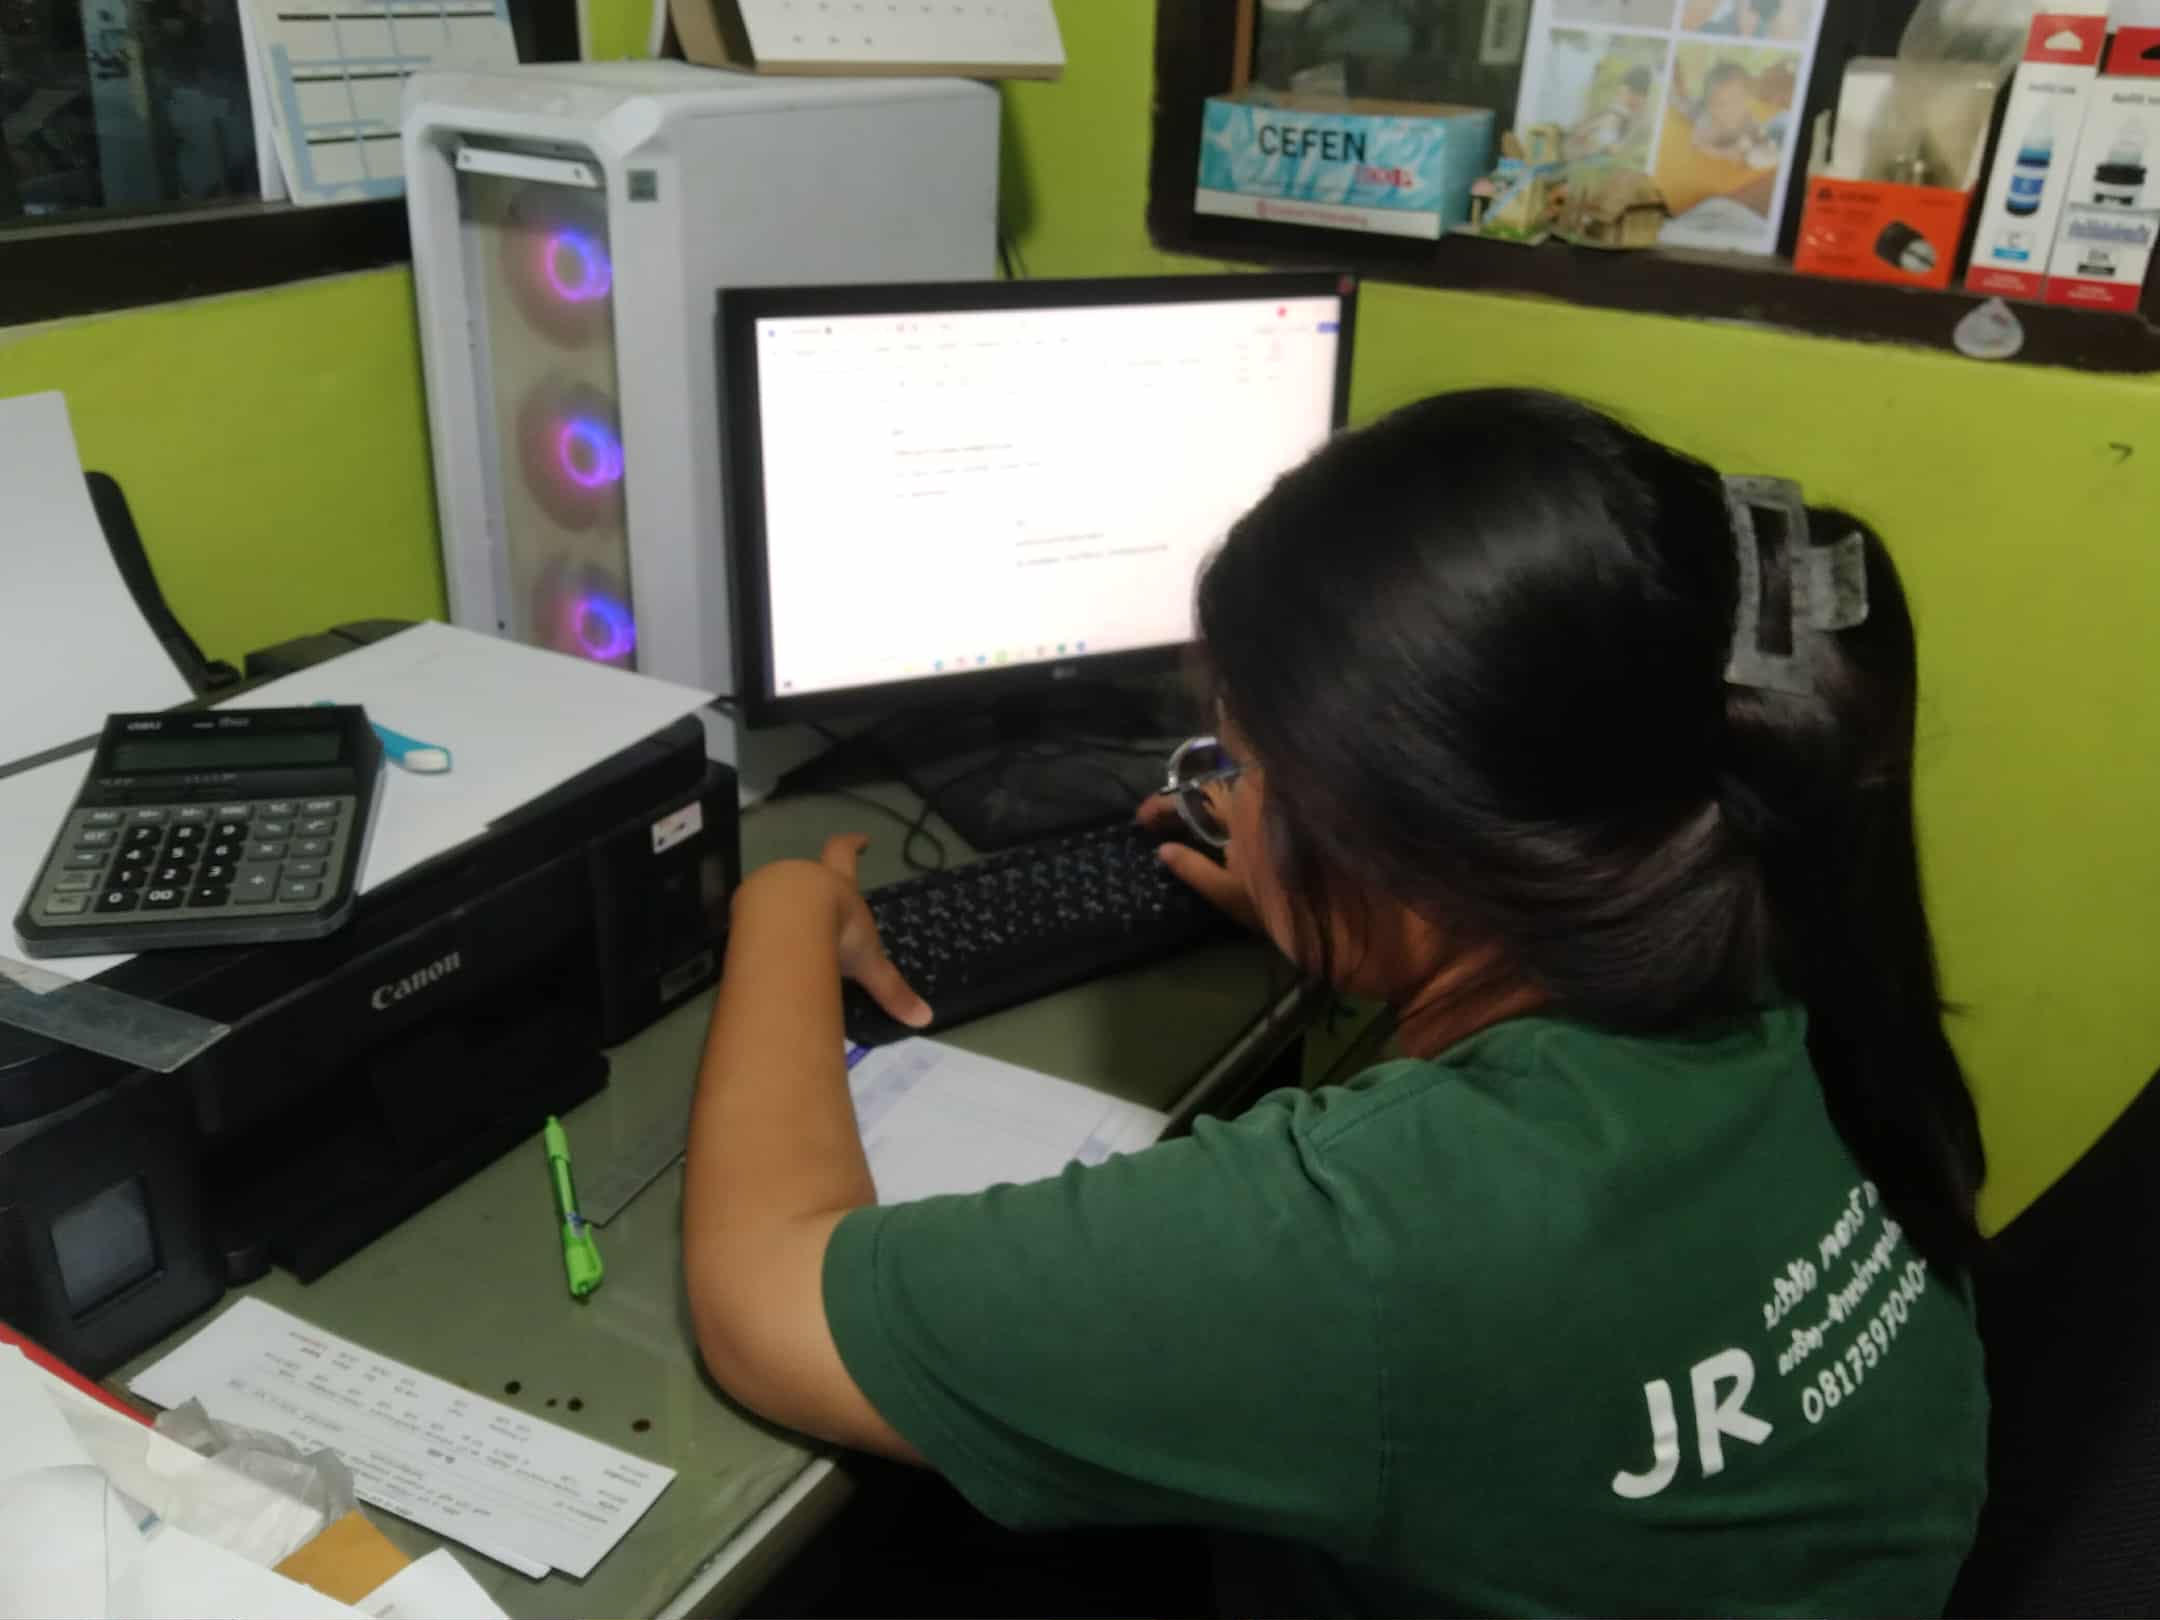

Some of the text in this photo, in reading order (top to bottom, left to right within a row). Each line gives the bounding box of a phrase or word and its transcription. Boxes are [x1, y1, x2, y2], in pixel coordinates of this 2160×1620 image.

[1258, 124, 1367, 163] CEFEN
[136, 828, 150, 840] 7
[177, 826, 192, 838] 8
[126, 845, 229, 860] 4 5 6
[121, 865, 222, 881] 1 2 3
[108, 889, 174, 903] 0 00
[371, 951, 461, 1011] Canon
[1612, 1347, 1774, 1499] JR
